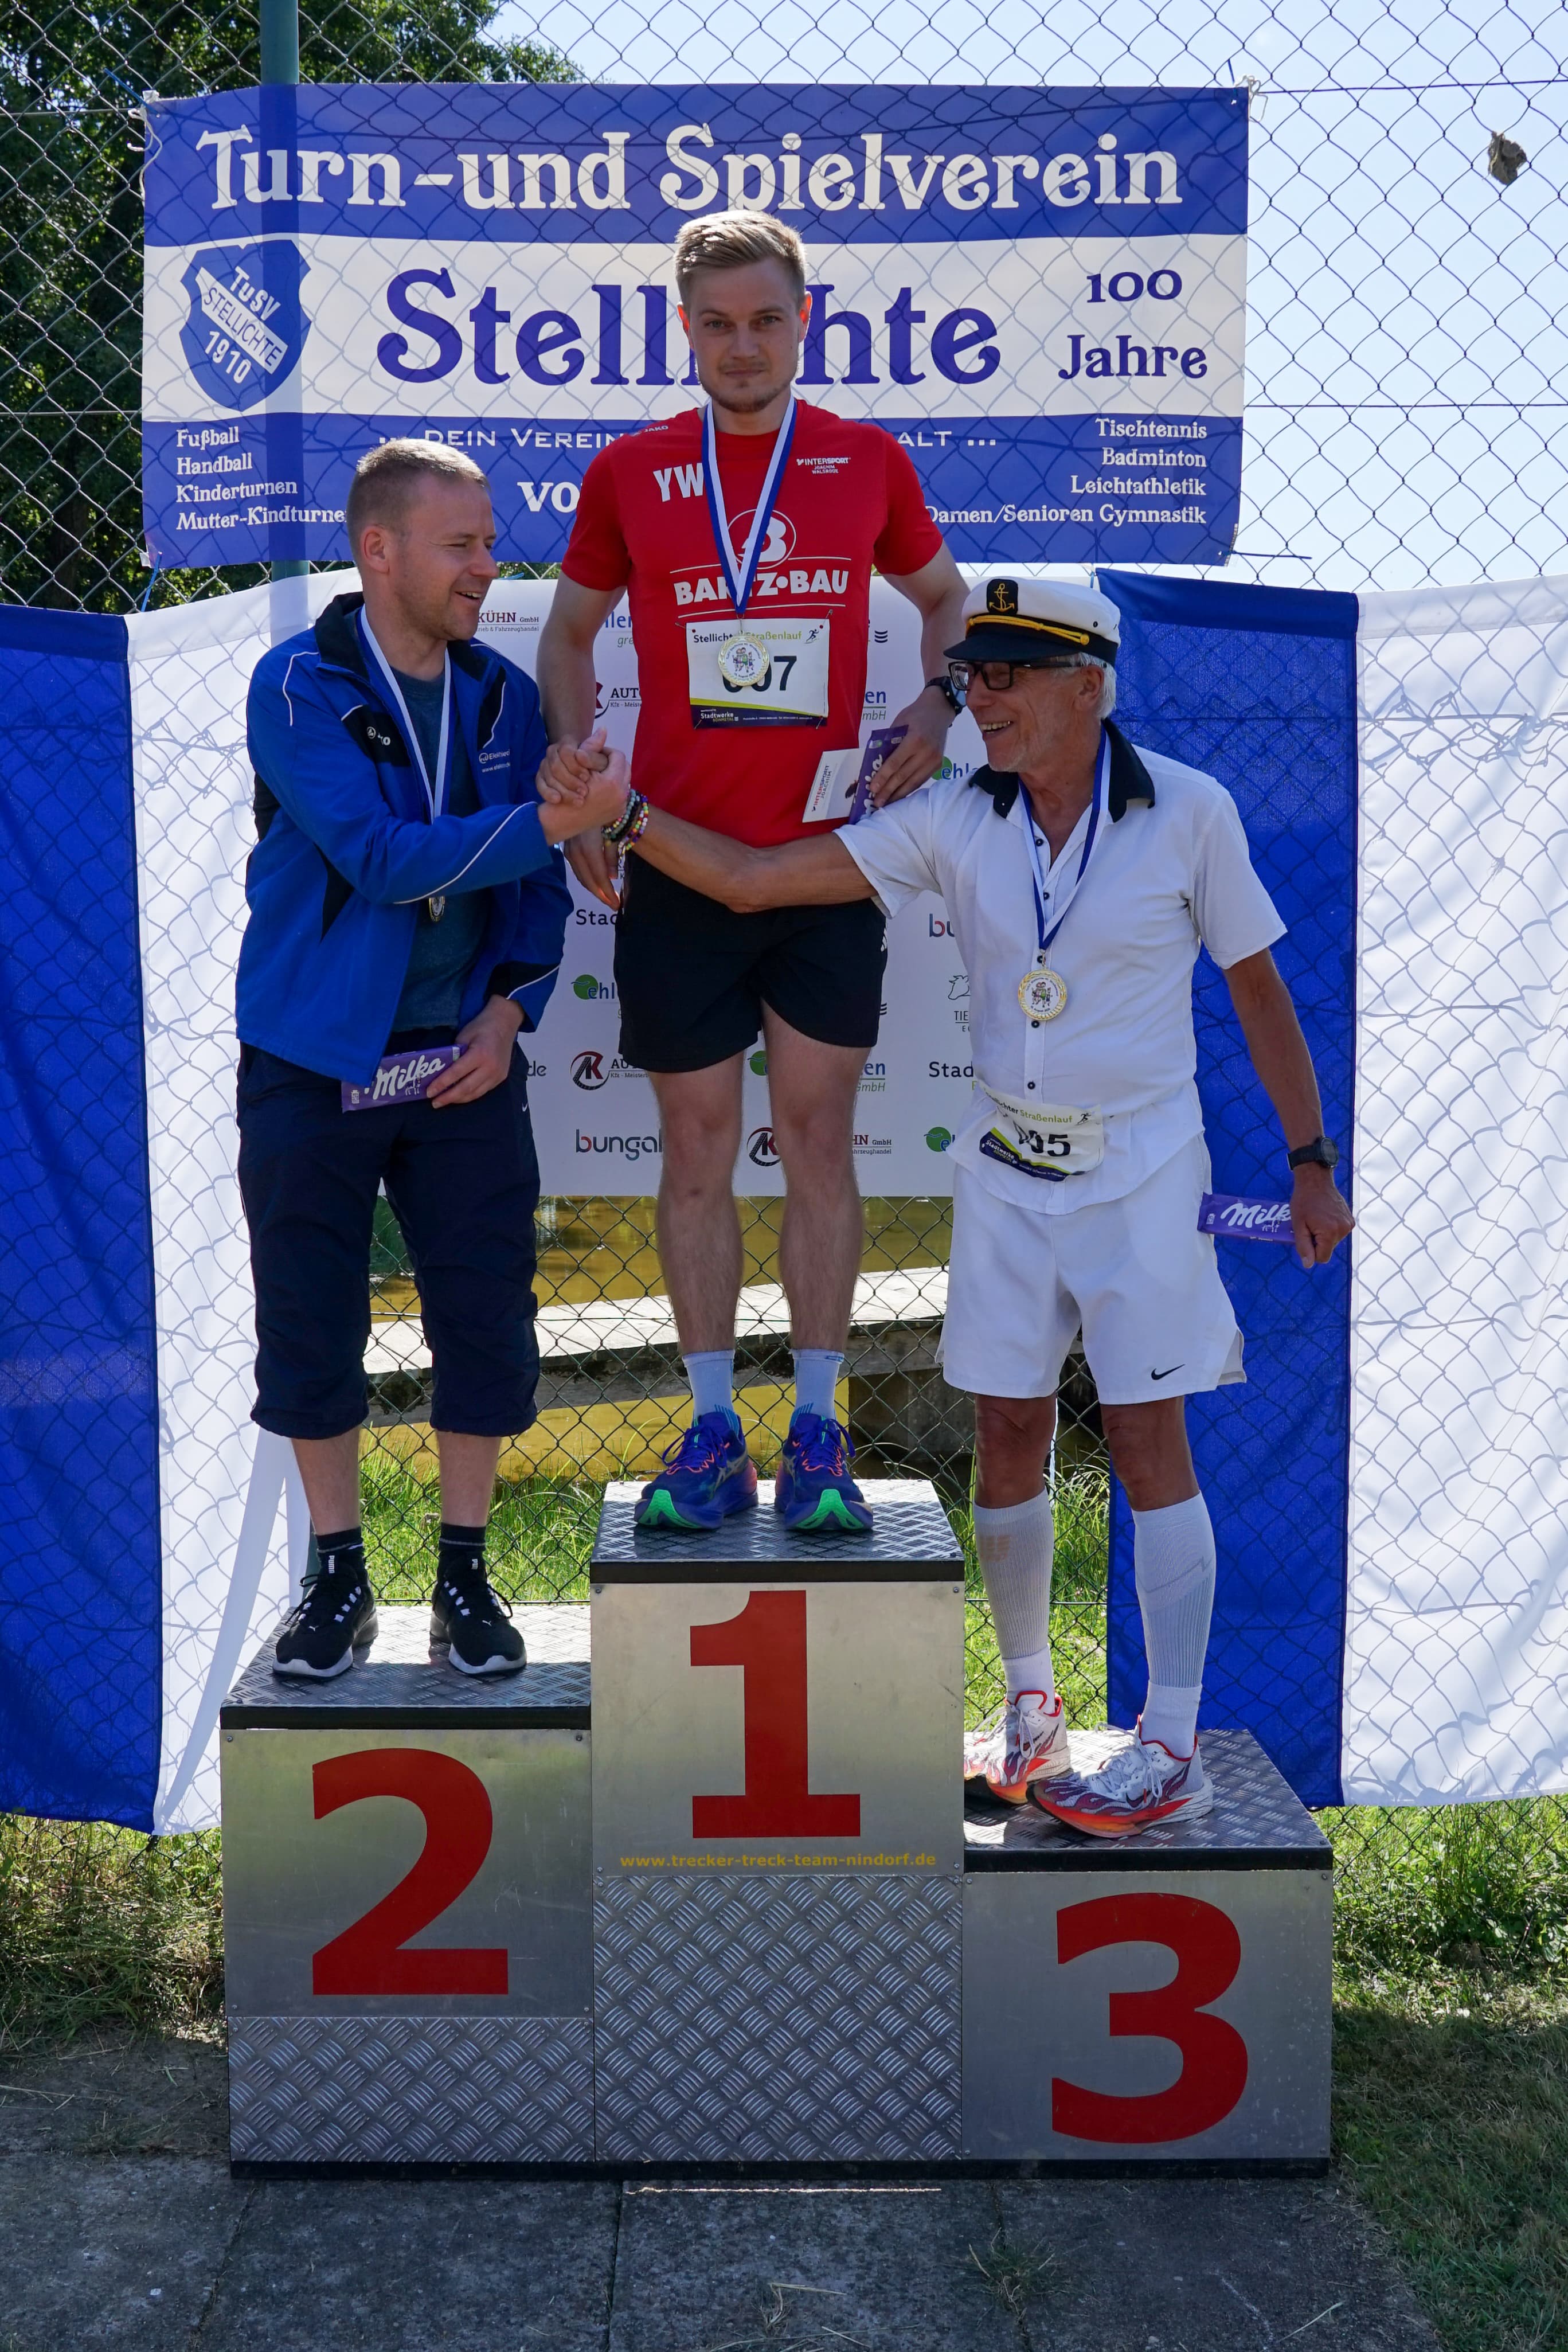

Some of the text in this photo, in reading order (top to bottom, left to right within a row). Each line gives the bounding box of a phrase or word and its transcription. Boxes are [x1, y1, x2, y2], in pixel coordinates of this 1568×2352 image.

[659, 124, 1183, 212] Spielverein
[230, 266, 281, 321] TuSV
[1086, 268, 1183, 303] 100
[204, 287, 283, 367] STELLICHTE
[377, 267, 1001, 386] Stellhte
[204, 331, 252, 384] 1910
[1058, 334, 1208, 380] Jahre
[176, 425, 240, 450] Fußball
[425, 429, 495, 447] DEIN
[510, 428, 622, 448] VEREIN
[1095, 417, 1207, 439] Tischtennis
[176, 452, 253, 475] Handball
[804, 457, 849, 466] INTERSPORT
[1101, 447, 1207, 468] Badminton
[175, 481, 298, 503] Kinderturnen
[1070, 475, 1207, 496] Leichtathletik
[1099, 503, 1207, 527] Gymnastik
[700, 711, 734, 719] Stadtwerke
[364, 1054, 445, 1100] Milka
[1019, 1109, 1073, 1123] Straßenlauf
[690, 1589, 861, 1839] 1
[311, 1747, 509, 1996] 2
[620, 1853, 937, 1867] www.trecker-treck-team-nindorf.de
[1051, 1892, 1249, 2144] 3
